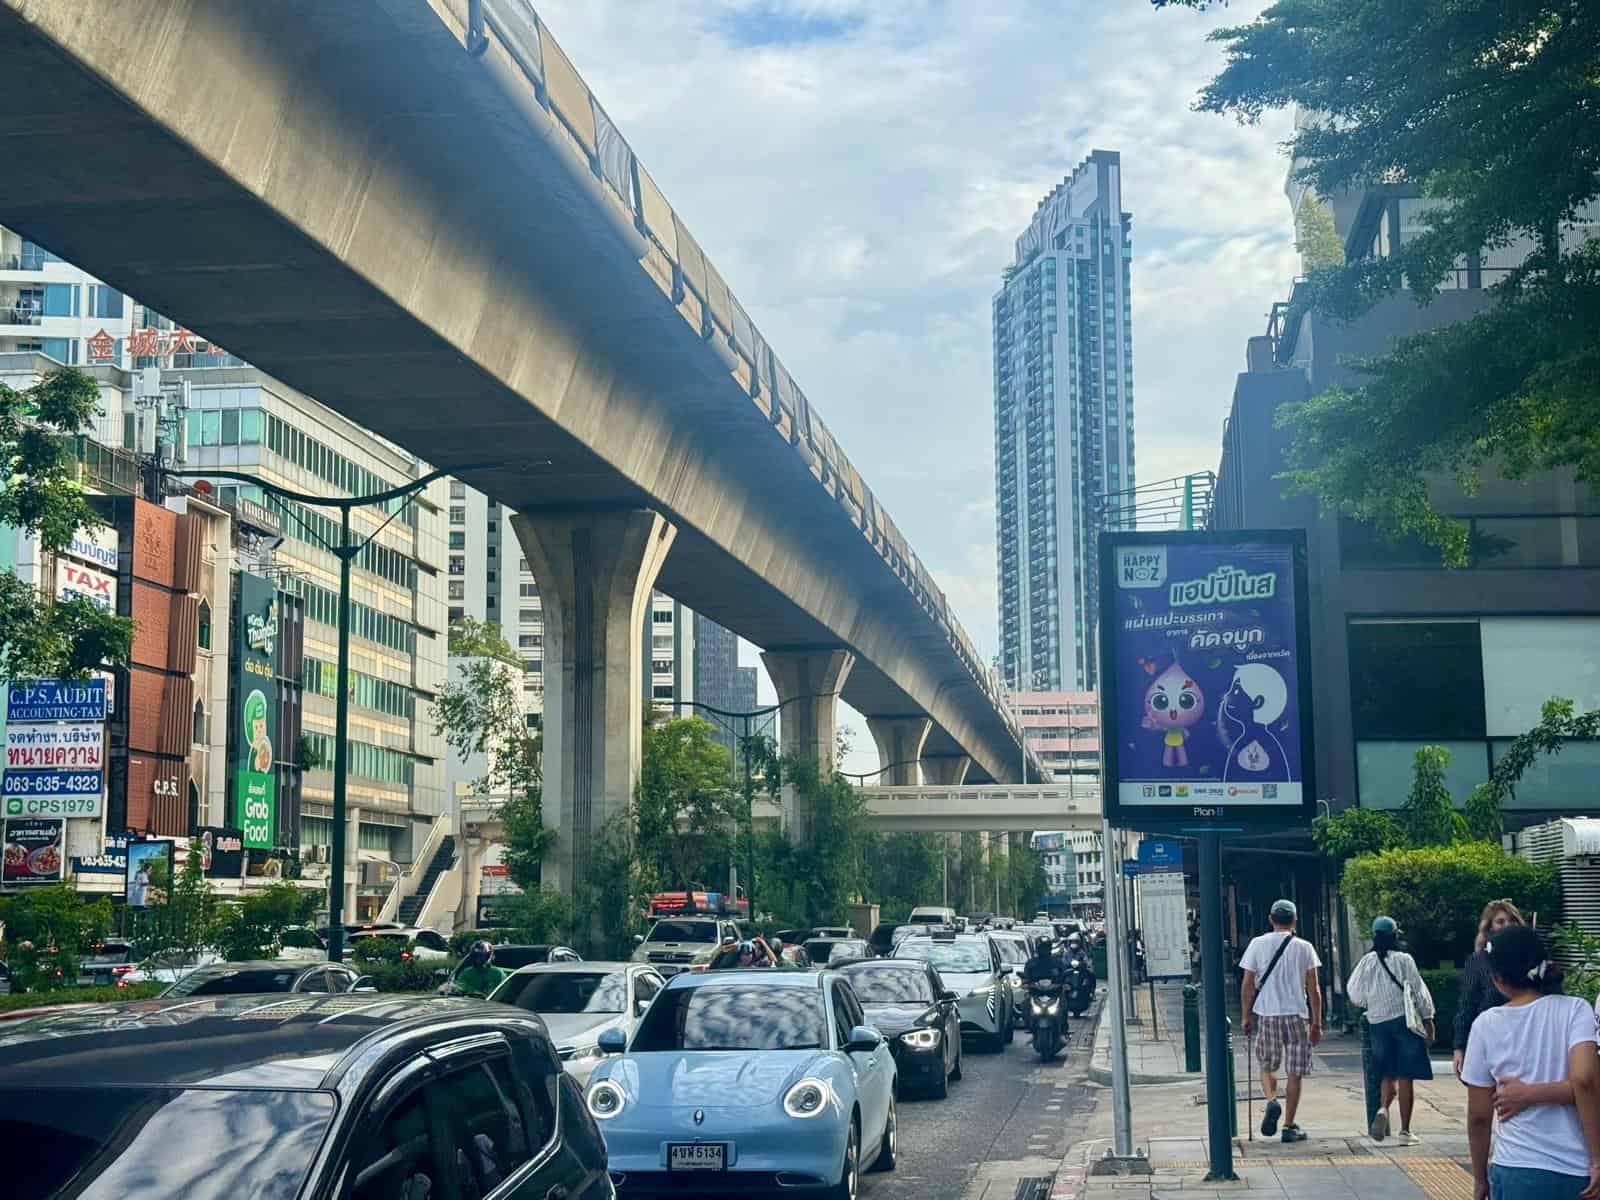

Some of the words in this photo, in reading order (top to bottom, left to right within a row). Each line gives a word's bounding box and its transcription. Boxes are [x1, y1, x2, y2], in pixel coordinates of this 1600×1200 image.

[1123, 554, 1161, 567] HAPPY
[64, 565, 111, 593] TAX
[1191, 628, 1264, 650] คัดจมูก
[54, 686, 104, 705] AUDIT
[7, 746, 100, 766] ทนายความ
[4, 775, 99, 793] 063-635-4323
[153, 779, 179, 797] C.P.S.
[27, 799, 95, 814] CPS1979
[244, 797, 269, 819] Grab
[1193, 807, 1215, 816] Plan
[243, 819, 269, 842] Food
